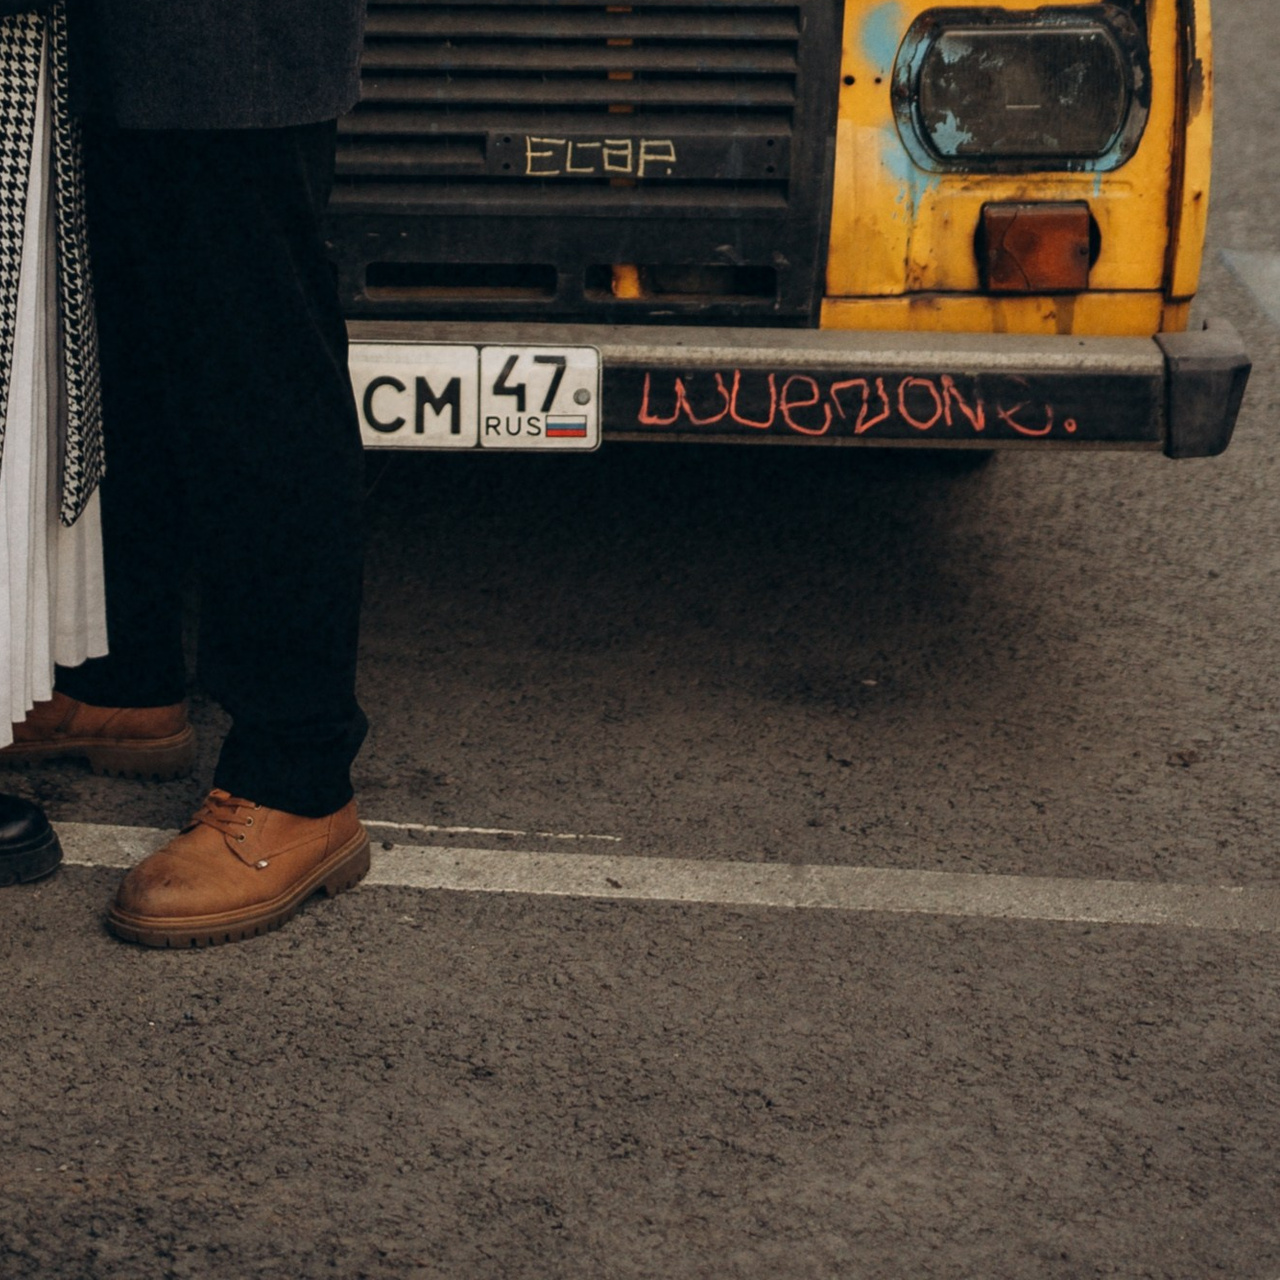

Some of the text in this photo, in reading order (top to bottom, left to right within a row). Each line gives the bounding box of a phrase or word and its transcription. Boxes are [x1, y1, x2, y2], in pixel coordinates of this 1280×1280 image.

[362, 354, 567, 435] CM 47
[485, 415, 543, 437] RUS
